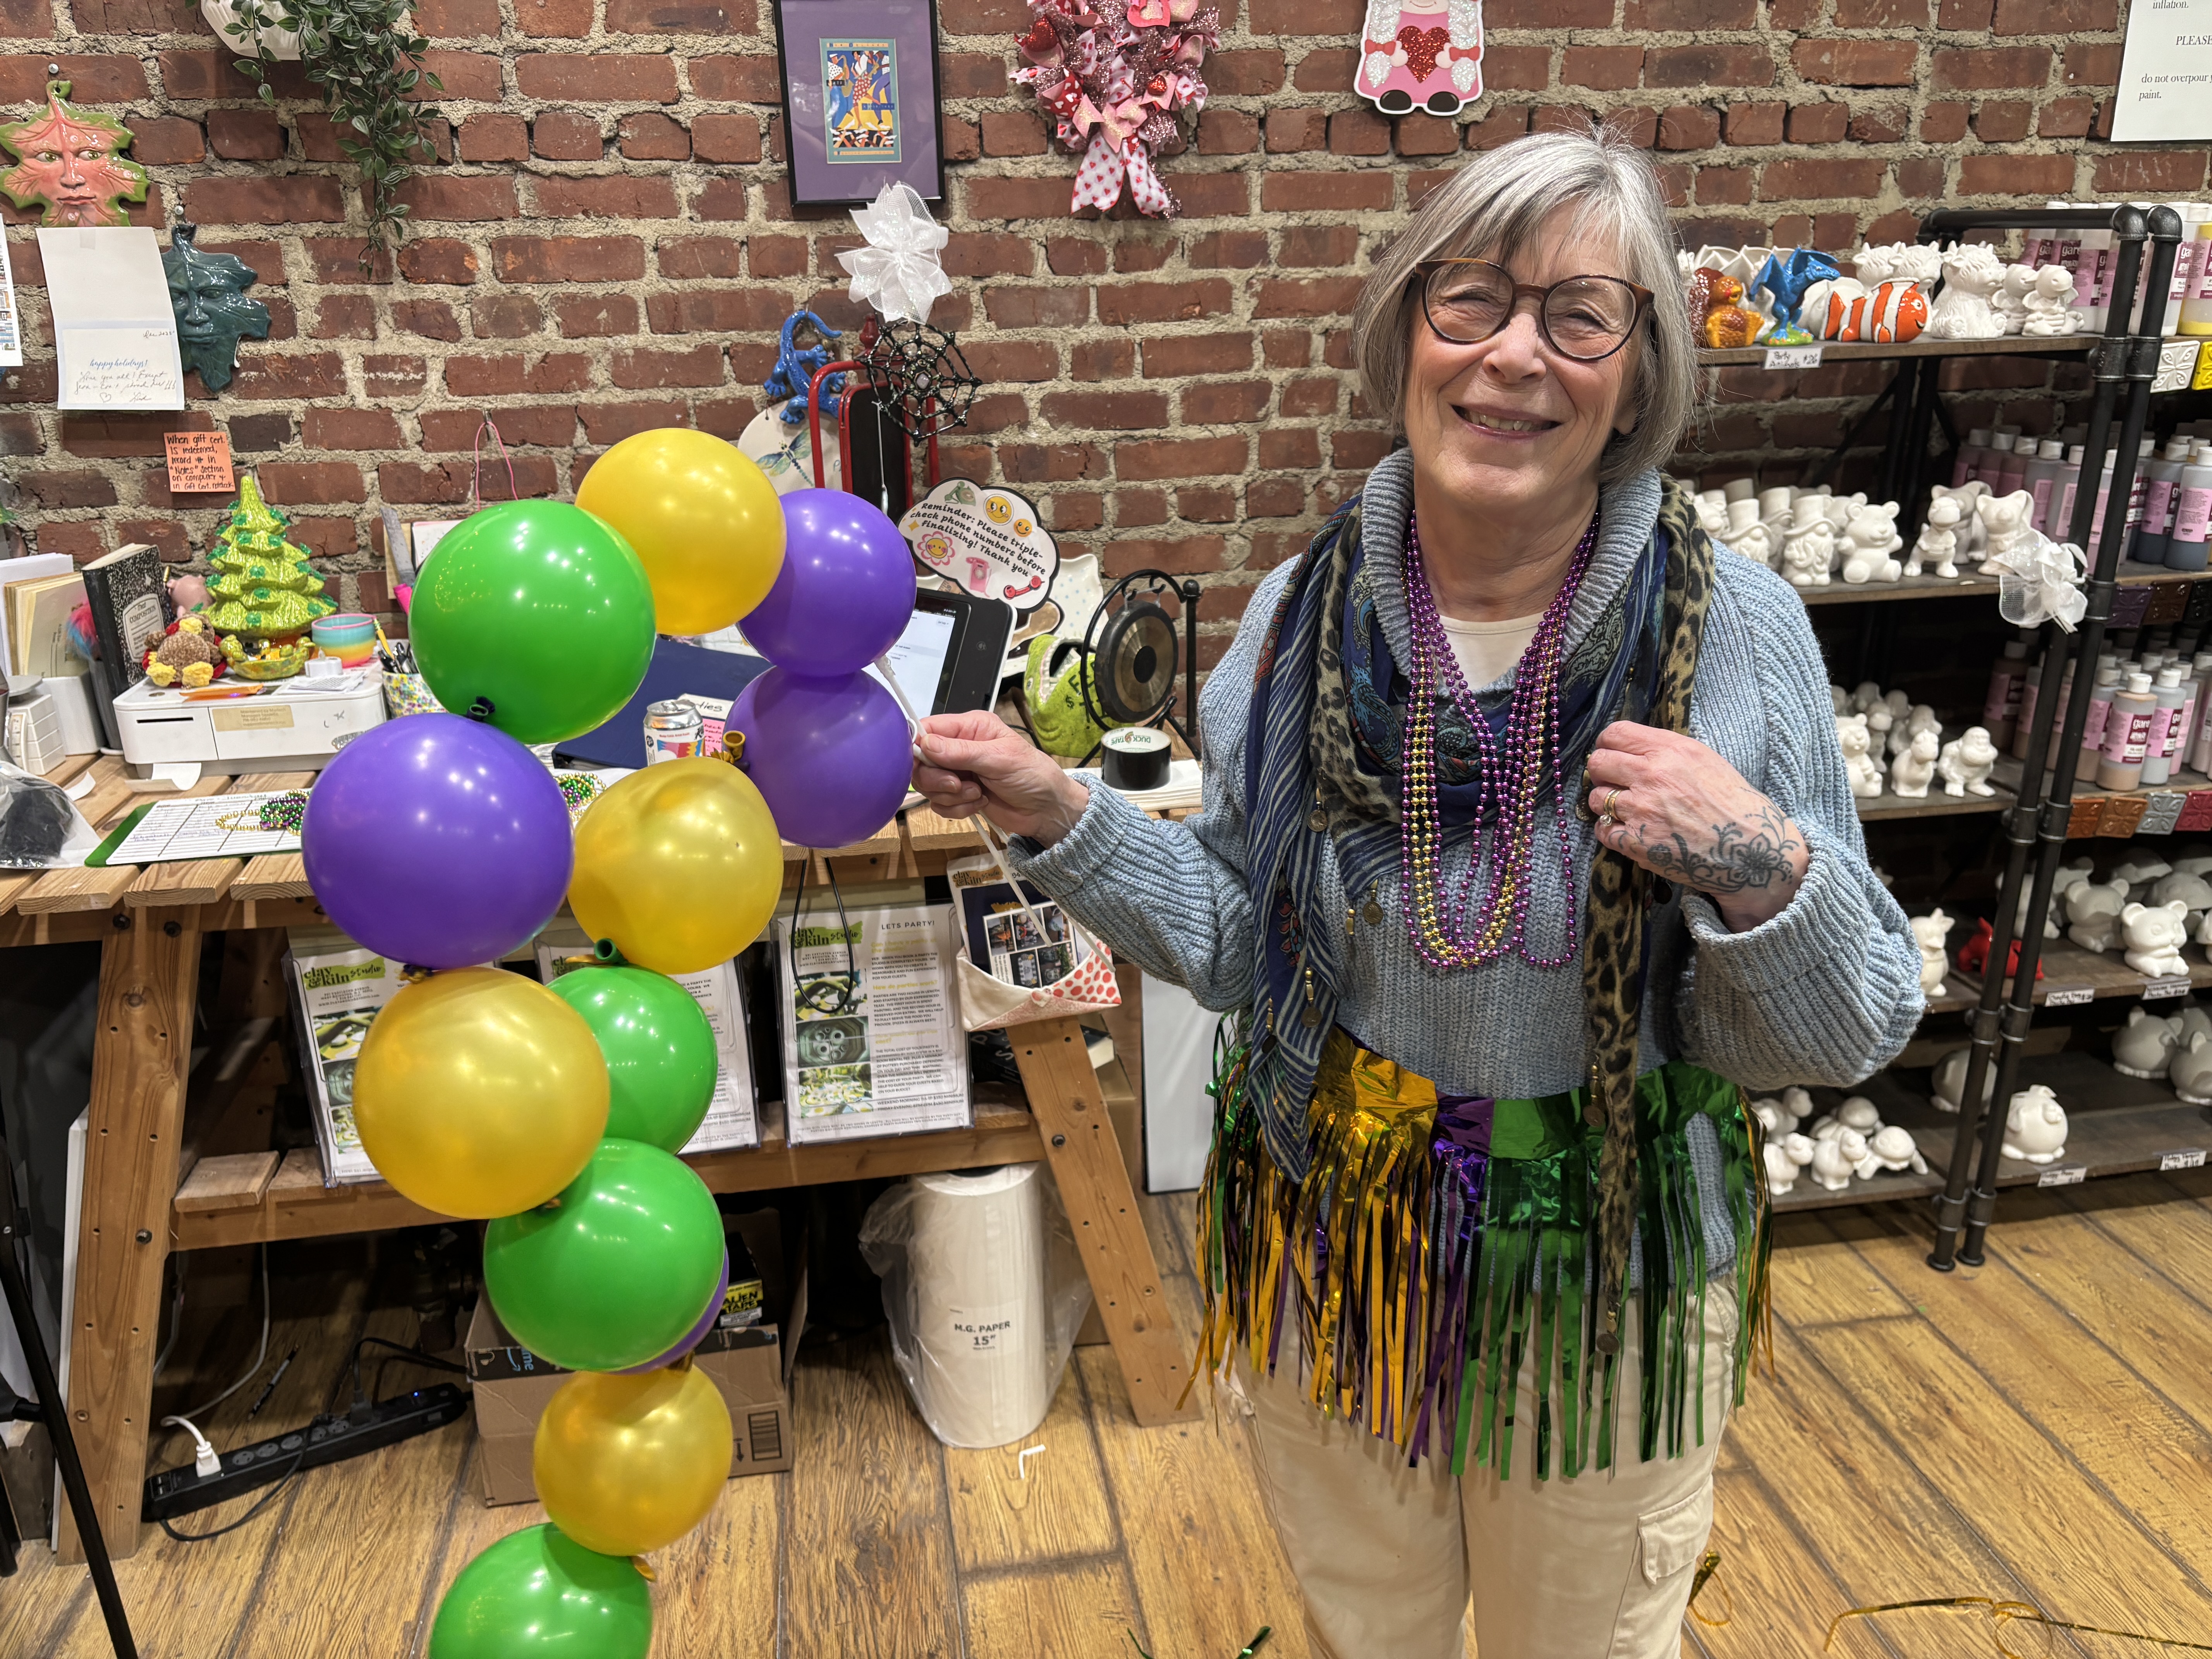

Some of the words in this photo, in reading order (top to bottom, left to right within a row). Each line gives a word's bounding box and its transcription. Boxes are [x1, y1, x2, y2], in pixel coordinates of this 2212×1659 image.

[2176, 35, 2212, 46] PLEASE
[2142, 73, 2152, 83] do
[2155, 74, 2169, 83] not
[2171, 74, 2208, 84] overpour
[2139, 89, 2162, 101] paint.
[90, 359, 113, 370] happy
[114, 359, 148, 370] holidays!
[167, 434, 188, 445] When
[193, 434, 206, 447] gift
[210, 435, 225, 443] cert.
[183, 445, 217, 454] redeemed,
[172, 456, 191, 464] record
[208, 455, 216, 464] in
[170, 465, 198, 475] "Notes"
[201, 465, 224, 474] section
[185, 474, 215, 483] computer
[921, 502, 976, 524] Reminder:
[977, 519, 1008, 542] Please
[1011, 537, 1044, 559] triple-
[910, 511, 939, 520] check
[942, 515, 972, 533] phone
[973, 530, 1015, 557] numbers
[1017, 553, 1046, 575] before
[921, 520, 978, 549] finalizing!
[980, 544, 1010, 566] Thank
[1012, 562, 1029, 577] you
[1110, 737, 1125, 746] TAPE
[795, 927, 815, 938] lay
[805, 929, 830, 946] kiln
[321, 969, 350, 986] kiln
[725, 1290, 758, 1303] ALIEN
[955, 1323, 976, 1333] M.G.
[979, 1321, 1010, 1333] PAPER
